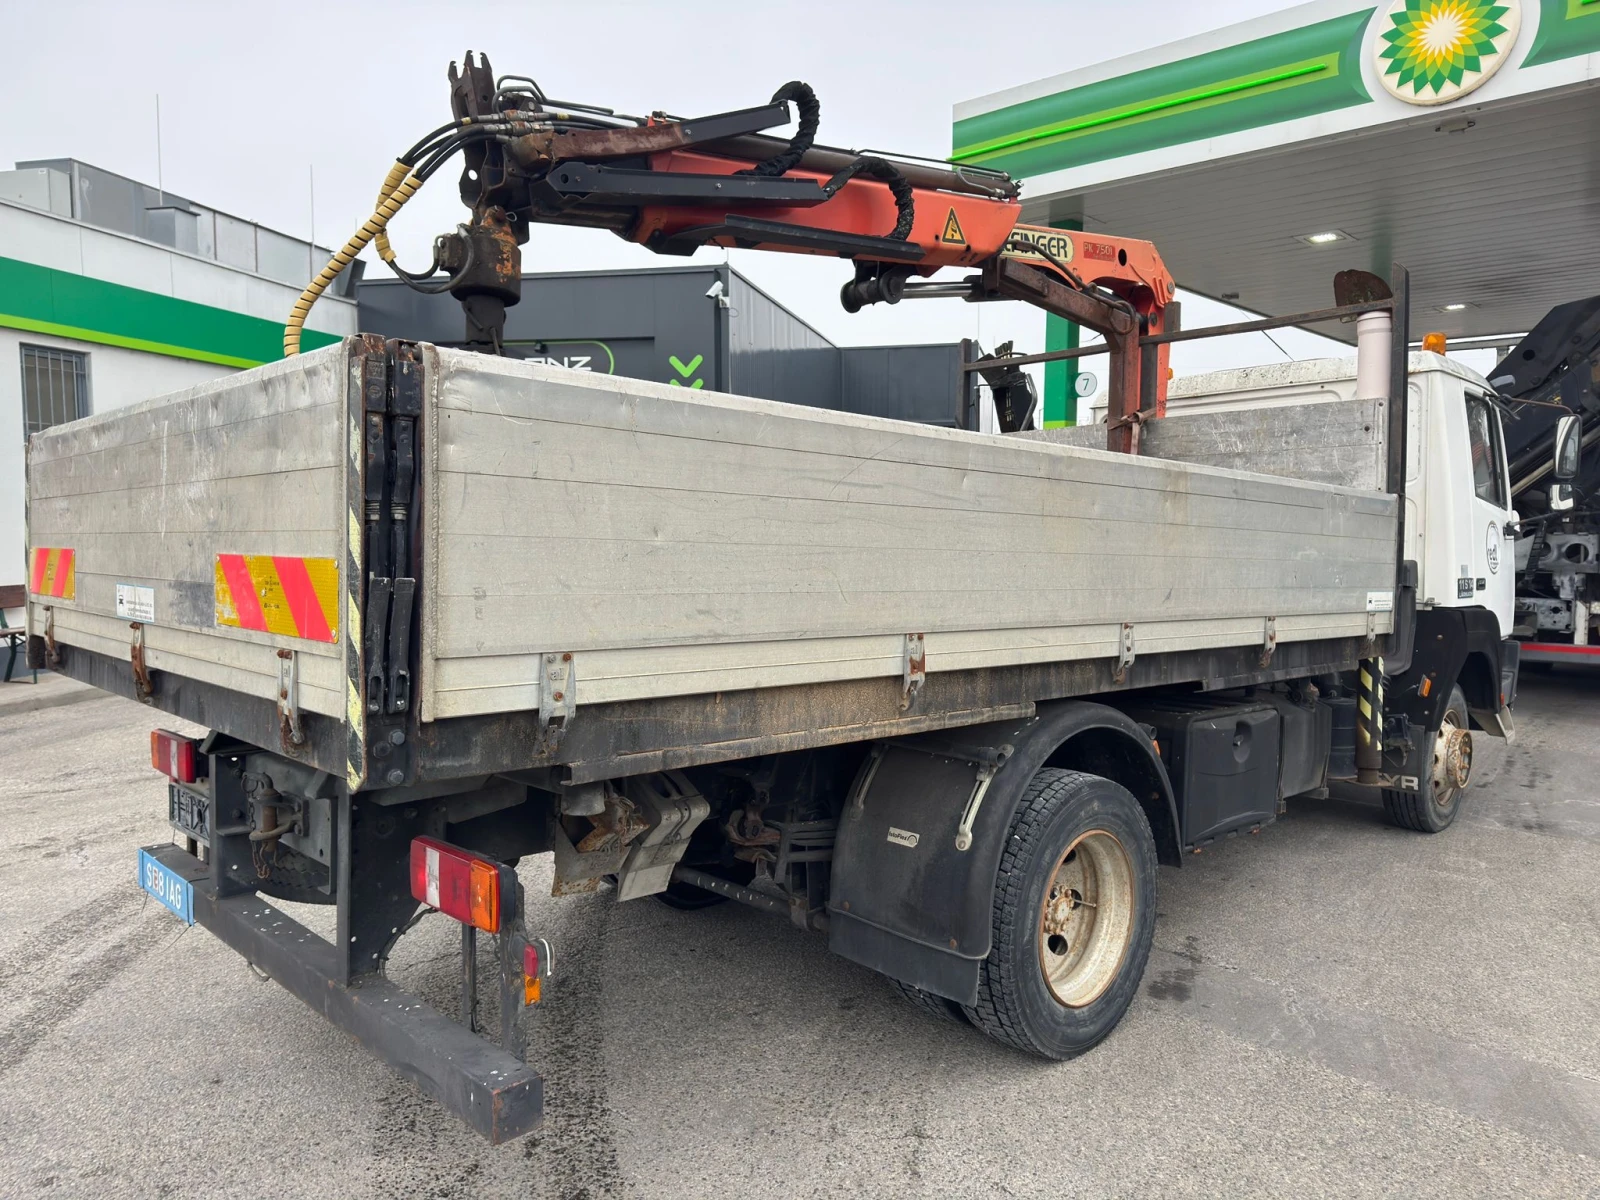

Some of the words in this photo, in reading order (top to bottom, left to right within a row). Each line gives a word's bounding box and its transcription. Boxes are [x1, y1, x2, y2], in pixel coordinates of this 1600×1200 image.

[1083, 242, 1094, 254] PK
[1096, 243, 1113, 256] 7501
[1082, 377, 1090, 391] 7
